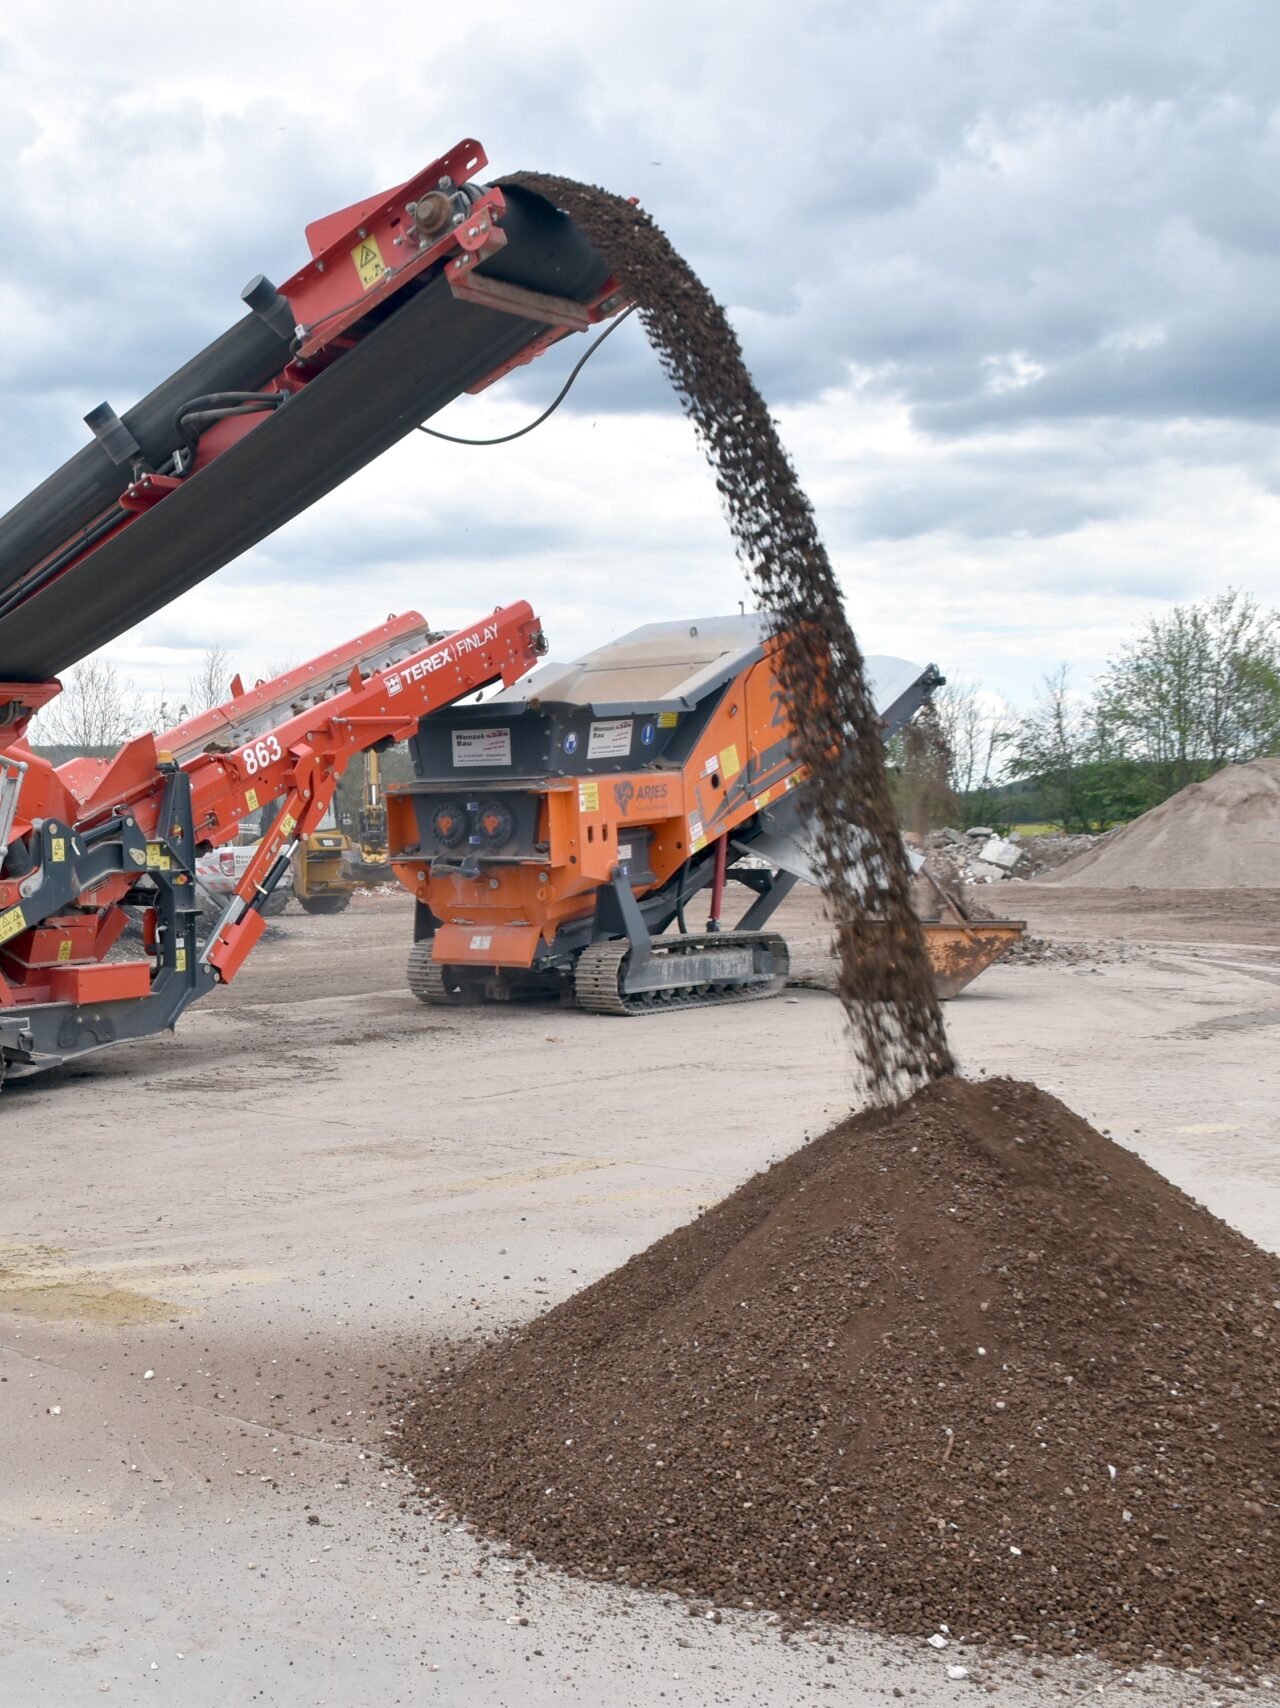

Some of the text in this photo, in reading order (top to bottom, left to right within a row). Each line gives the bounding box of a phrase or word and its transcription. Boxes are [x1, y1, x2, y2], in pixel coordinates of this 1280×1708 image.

[401, 623, 498, 684] TEREX FINLAY
[243, 736, 281, 774] 863
[636, 783, 668, 802] ARJES
